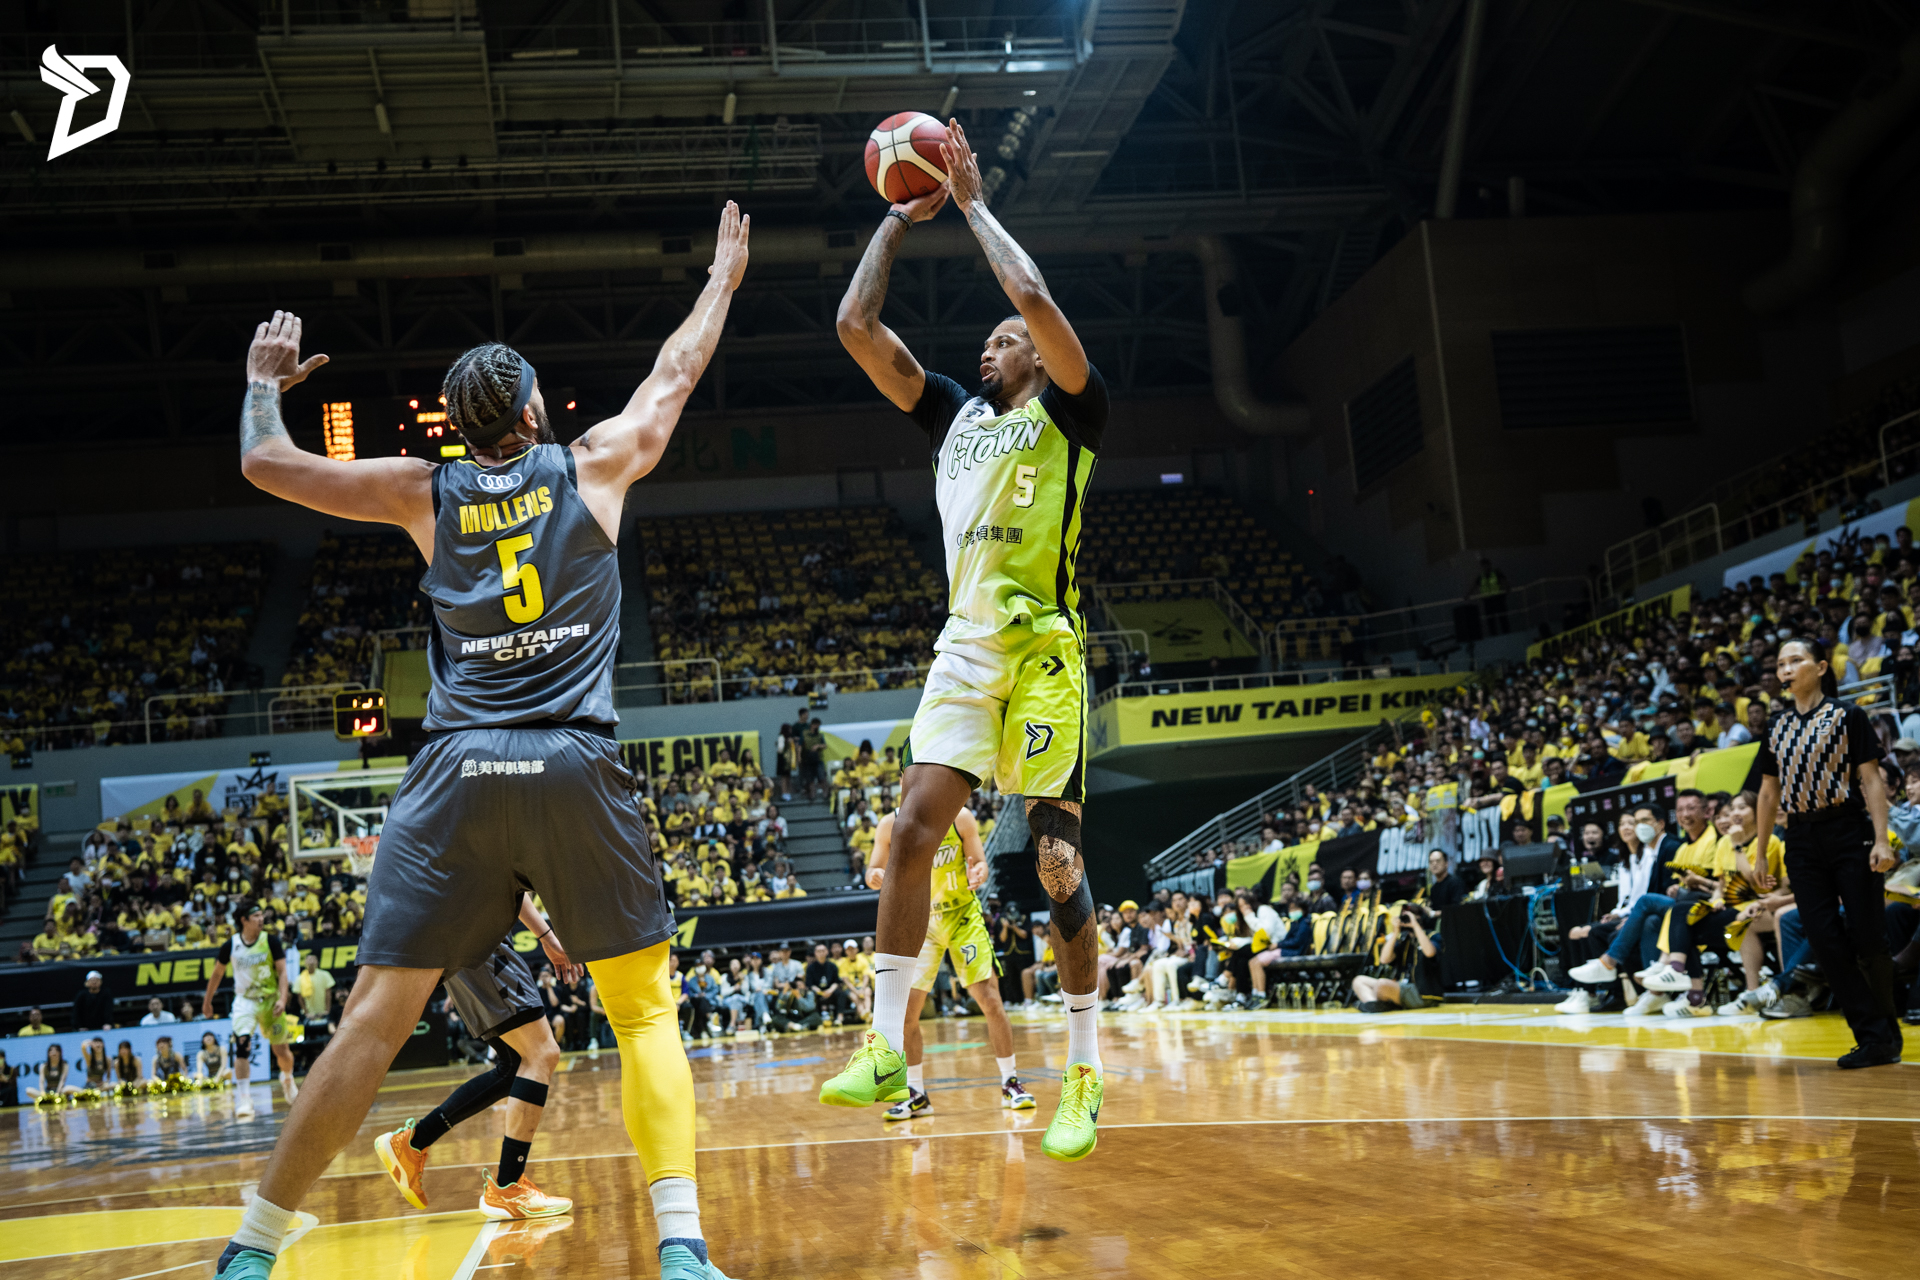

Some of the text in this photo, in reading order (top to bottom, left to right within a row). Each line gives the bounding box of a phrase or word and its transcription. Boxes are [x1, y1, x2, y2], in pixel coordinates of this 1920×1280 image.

[1012, 464, 1038, 508] 5
[459, 486, 553, 534] MULLENS
[495, 532, 545, 624] 5
[461, 623, 590, 654] NEW TAIPEI
[493, 641, 559, 661] CITY
[1151, 704, 1243, 727] NEW
[1252, 693, 1372, 720] TAIPEI
